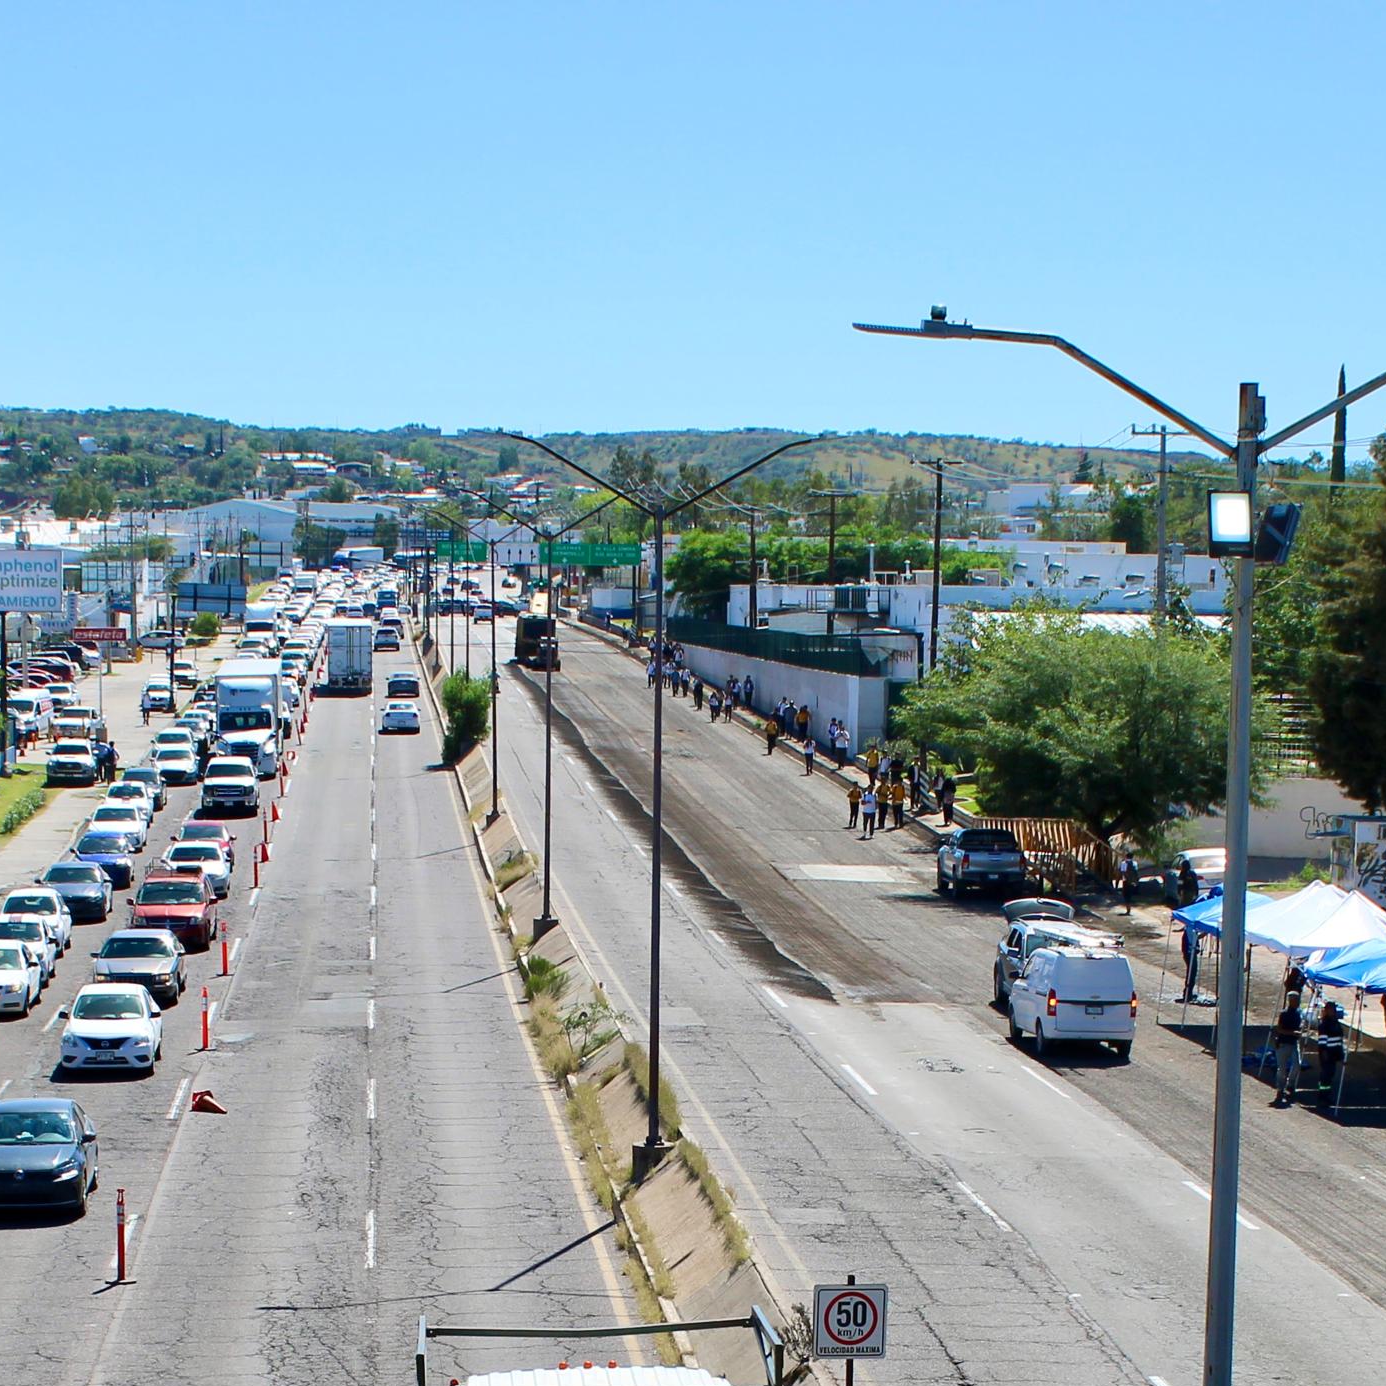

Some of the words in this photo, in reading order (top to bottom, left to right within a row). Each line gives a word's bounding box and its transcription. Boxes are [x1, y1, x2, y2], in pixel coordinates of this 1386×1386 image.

[75, 629, 124, 639] estafeta
[836, 1300, 868, 1327] 50
[837, 1328, 864, 1337] km/h
[819, 1346, 855, 1354] VELOCIDAD
[856, 1346, 881, 1354] MAXIMA
